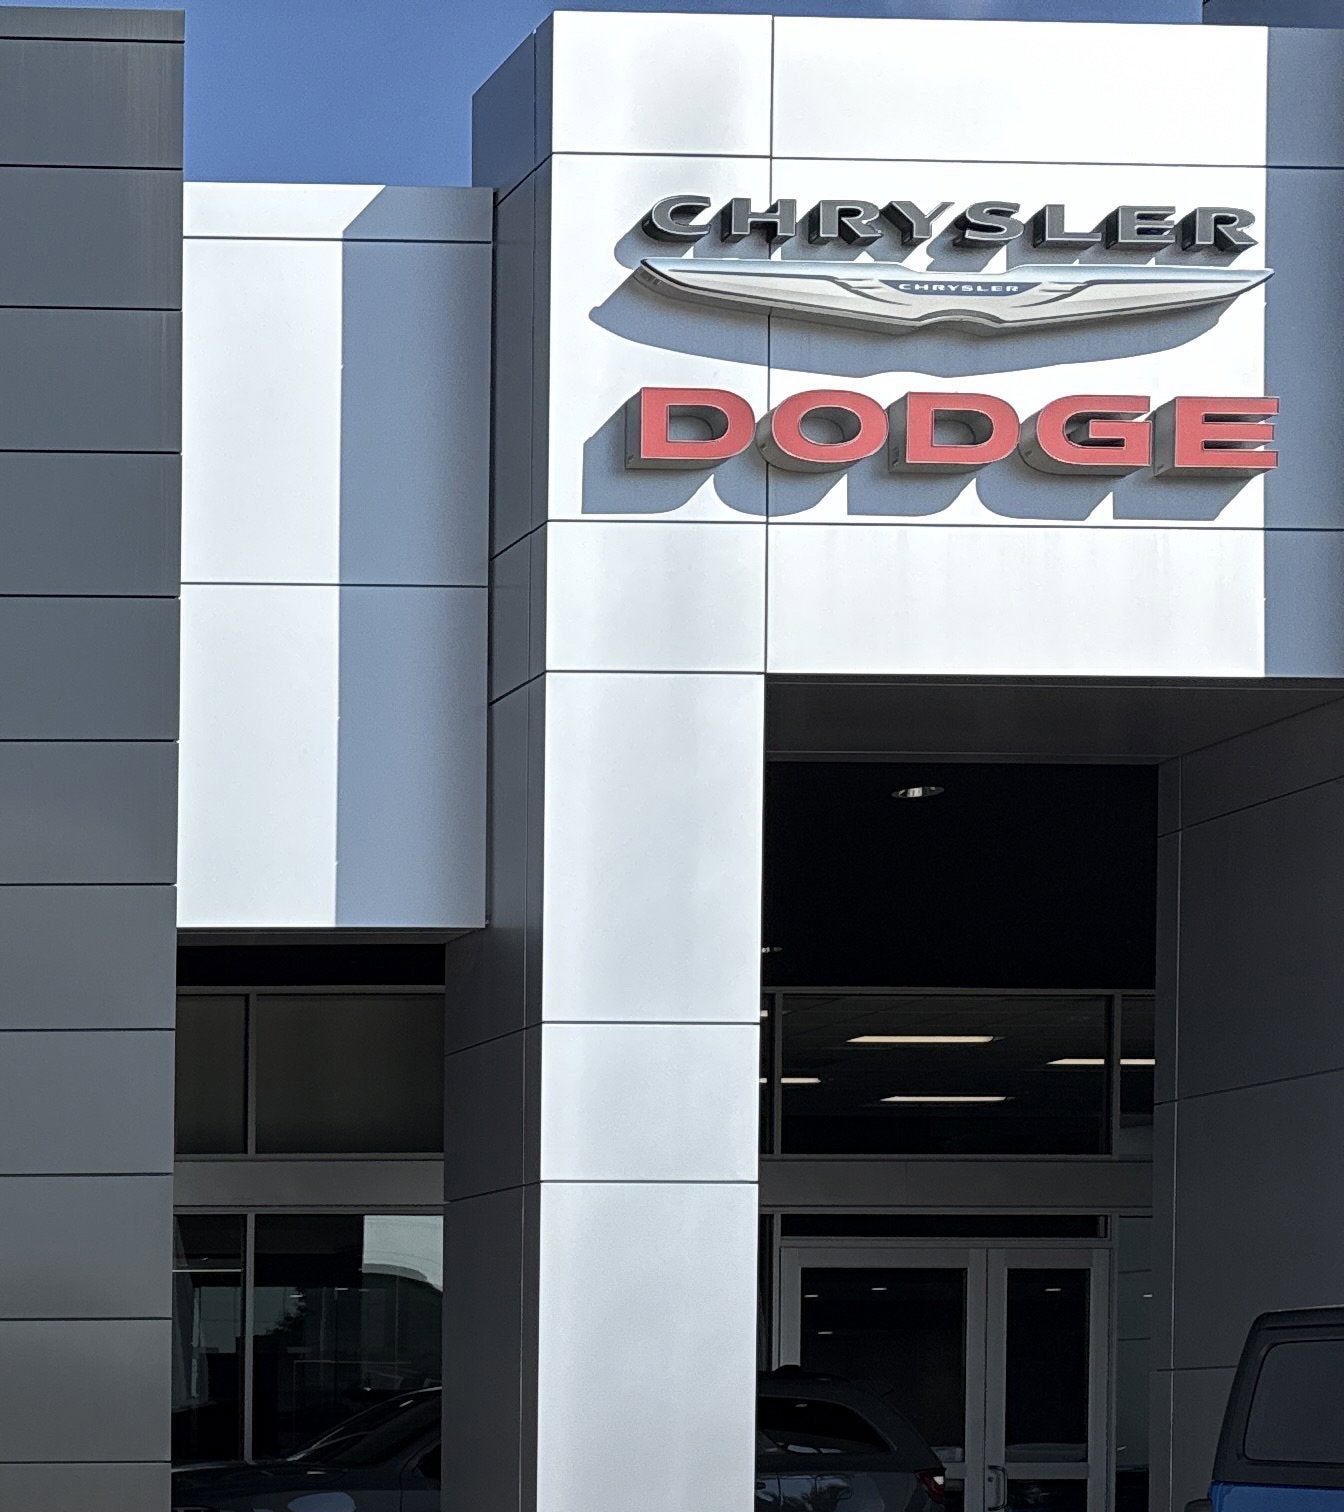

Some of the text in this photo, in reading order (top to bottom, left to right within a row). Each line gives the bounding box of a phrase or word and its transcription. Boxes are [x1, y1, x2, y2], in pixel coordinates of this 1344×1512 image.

[644, 195, 1258, 251] CHRYSLER
[898, 283, 1019, 292] CHRYSLER
[632, 387, 1280, 472] DODGE
